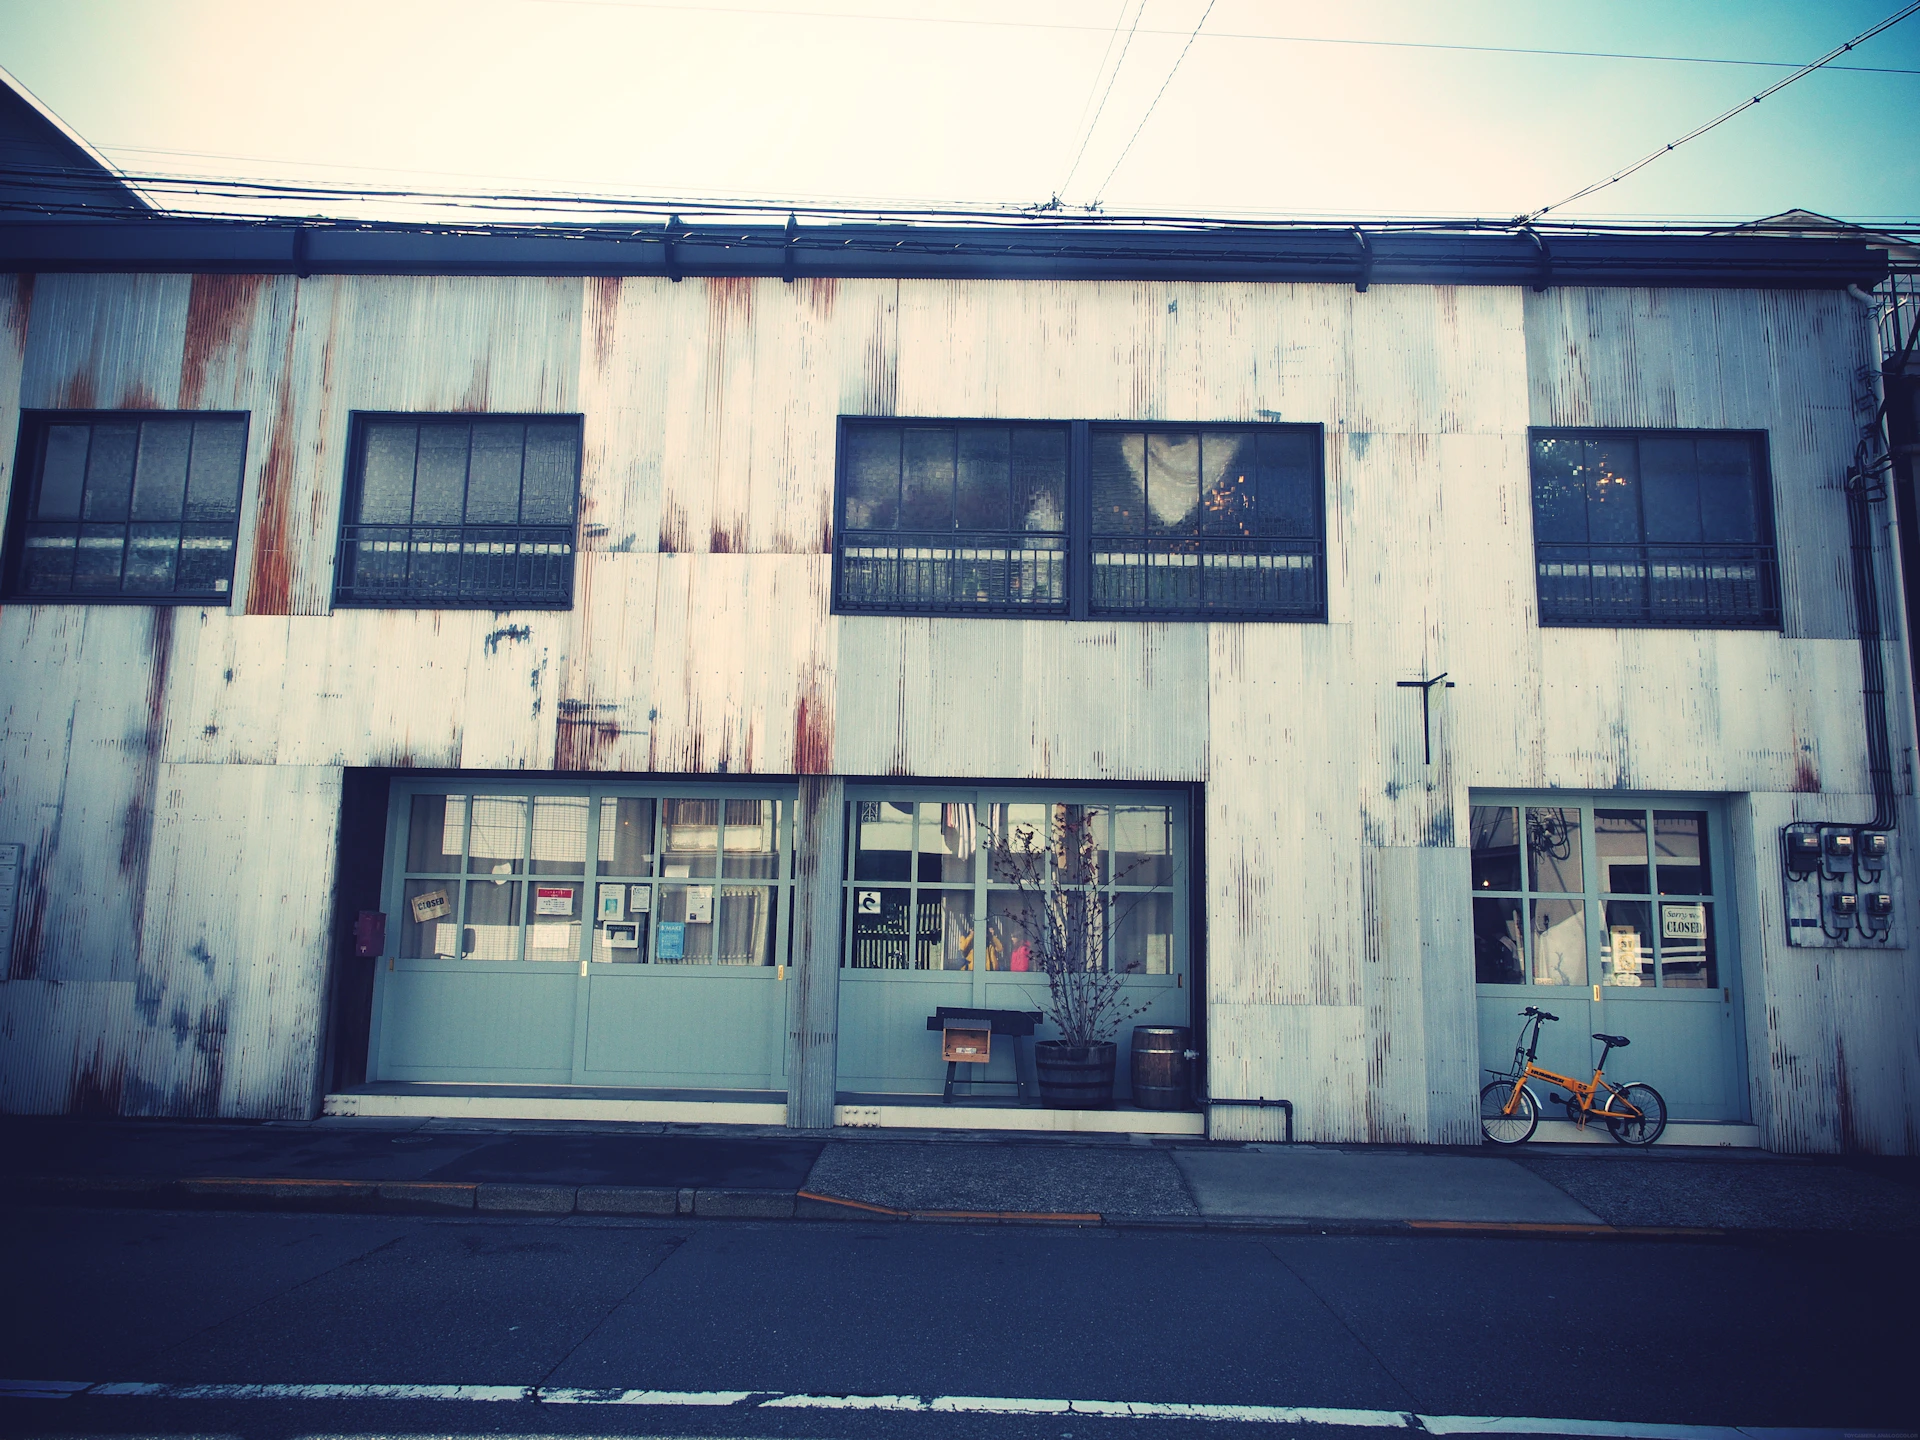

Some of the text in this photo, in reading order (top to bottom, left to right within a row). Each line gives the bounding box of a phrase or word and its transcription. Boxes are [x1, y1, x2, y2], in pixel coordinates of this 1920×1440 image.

[417, 897, 445, 911] CLOSED
[1667, 911, 1688, 920] Sorry
[1667, 921, 1702, 933] CLOSED
